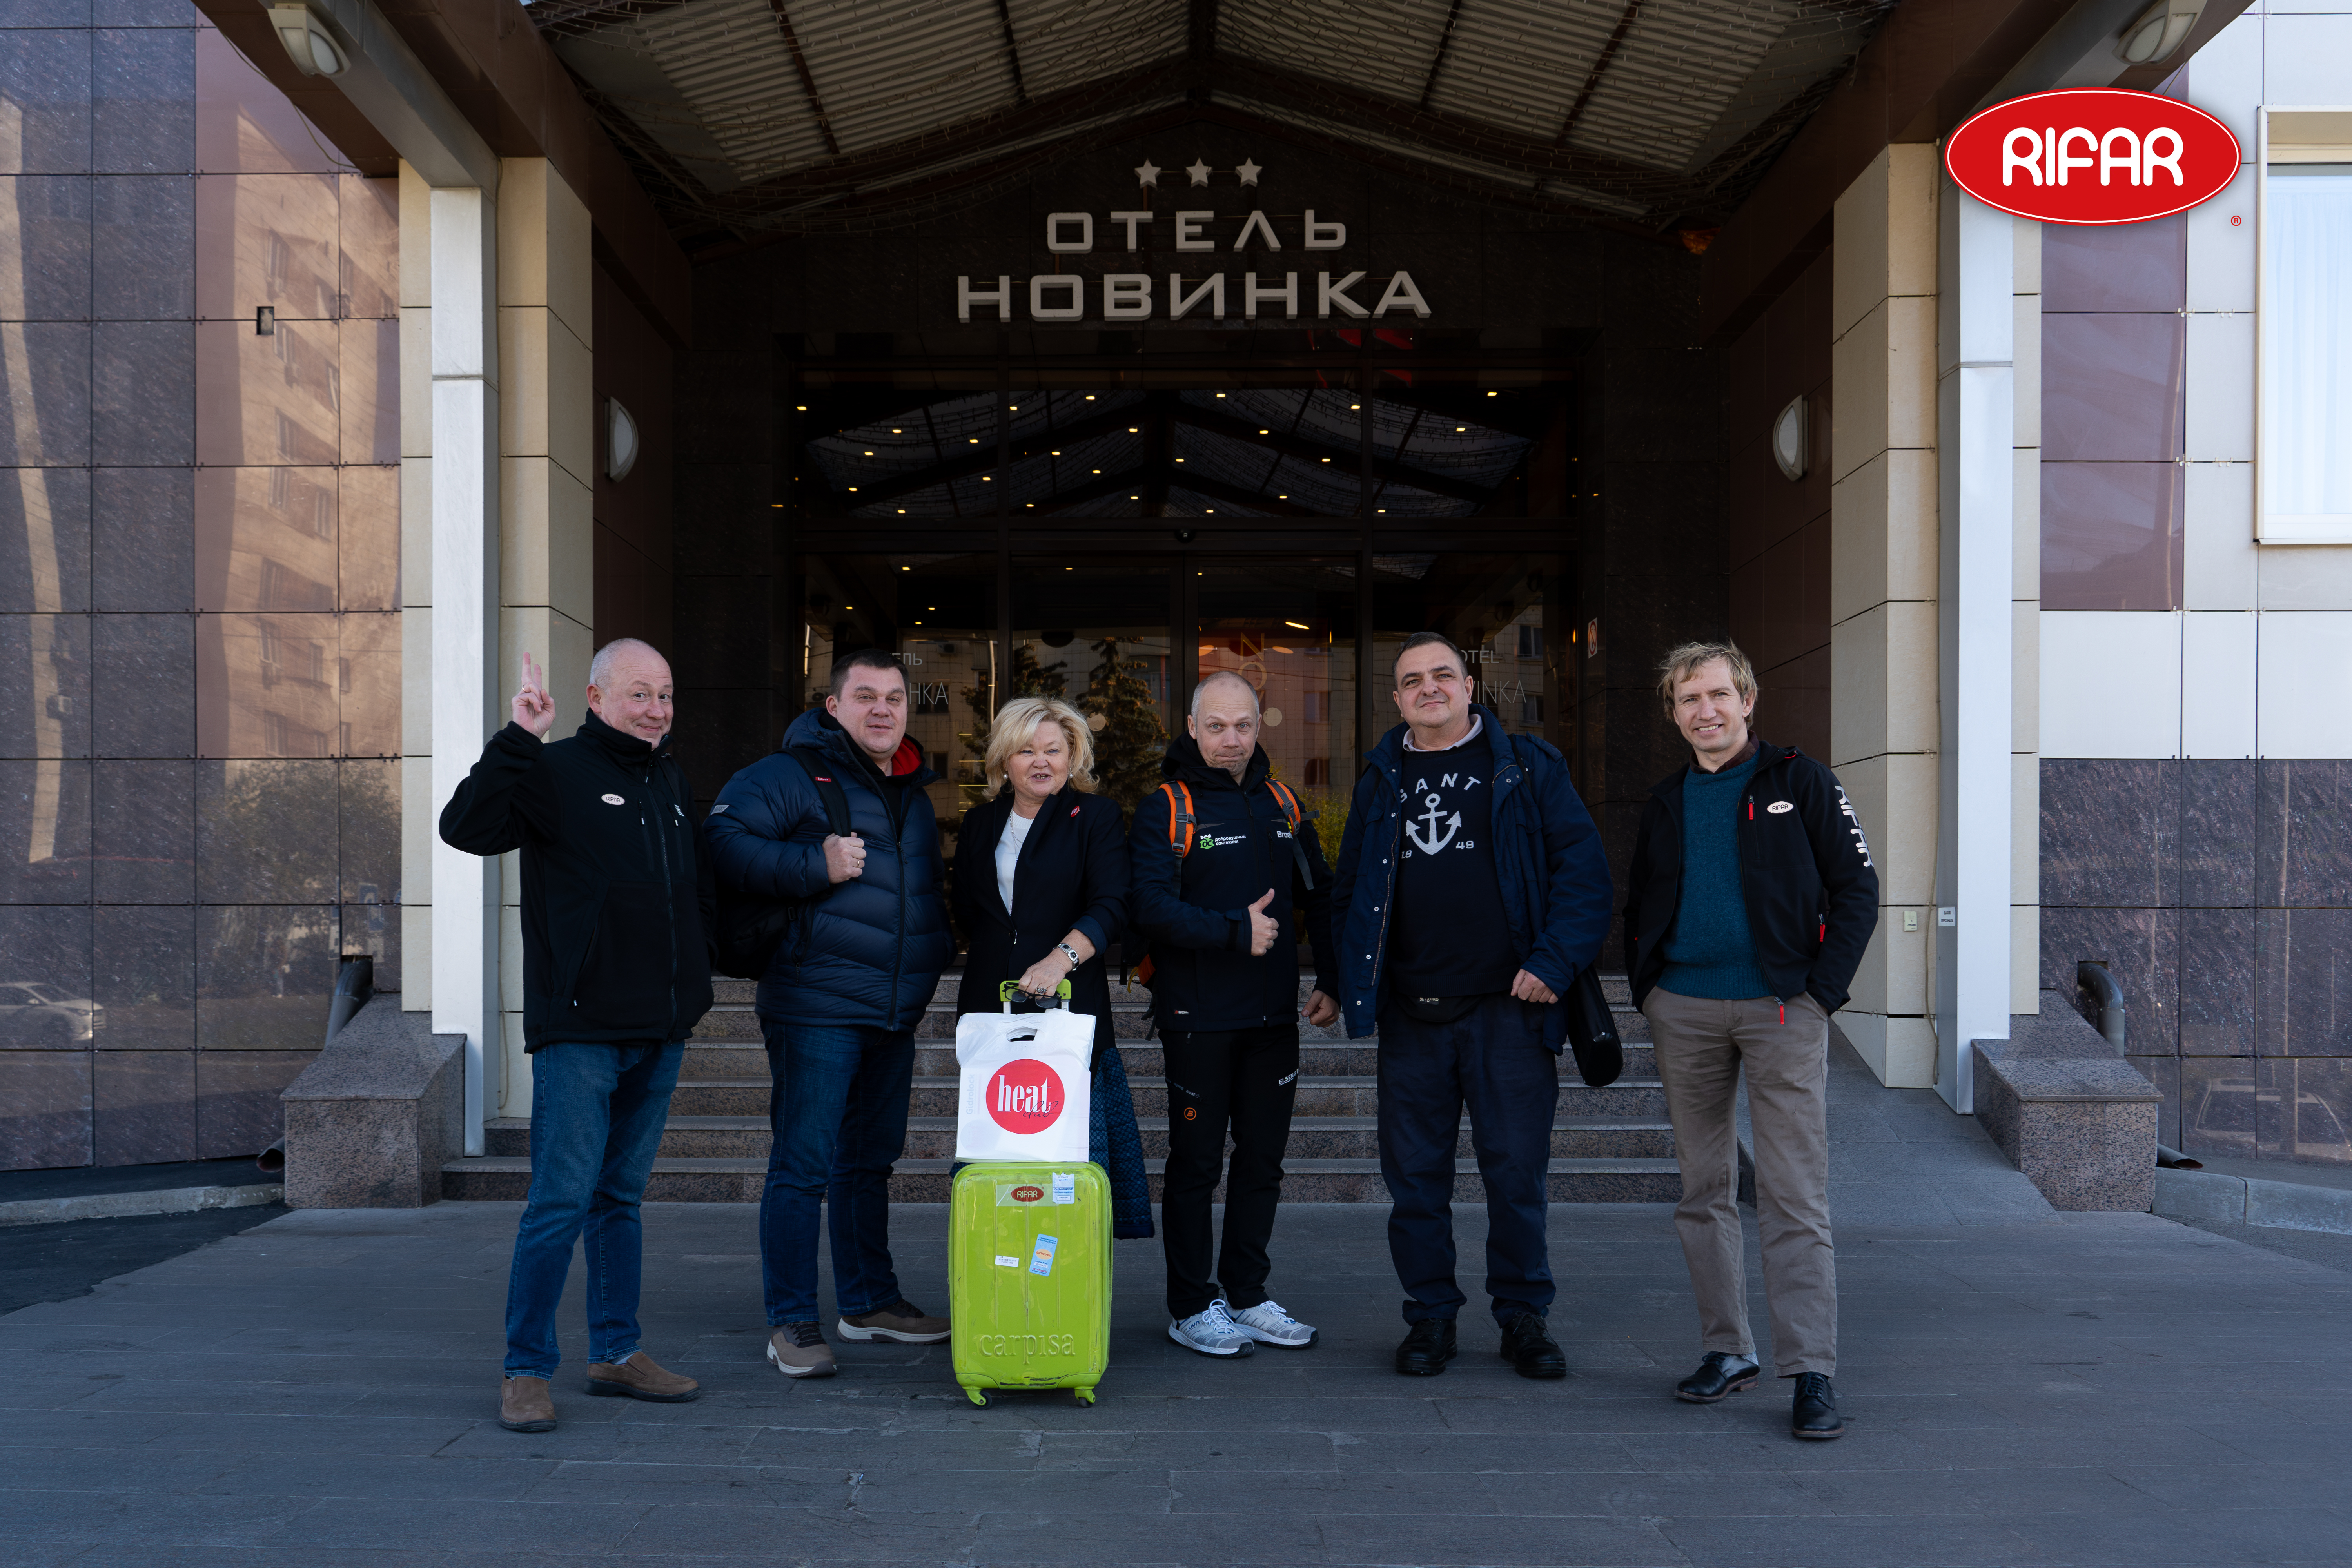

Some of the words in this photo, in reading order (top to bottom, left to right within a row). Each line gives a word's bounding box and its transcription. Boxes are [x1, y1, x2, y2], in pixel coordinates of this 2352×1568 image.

[1046, 209, 1347, 254] ОТЕЛЬ
[958, 270, 1432, 323] НОВИНКА
[1215, 834, 1246, 842] добродушный
[1835, 785, 1875, 868] RIFAR
[1401, 850, 1412, 859] 19
[1455, 840, 1474, 850] 49
[966, 1074, 975, 1115] Gidrolock
[996, 1075, 1051, 1113] heat
[1278, 1073, 1294, 1085] ELSEN
[979, 1334, 1076, 1365] carpisa
